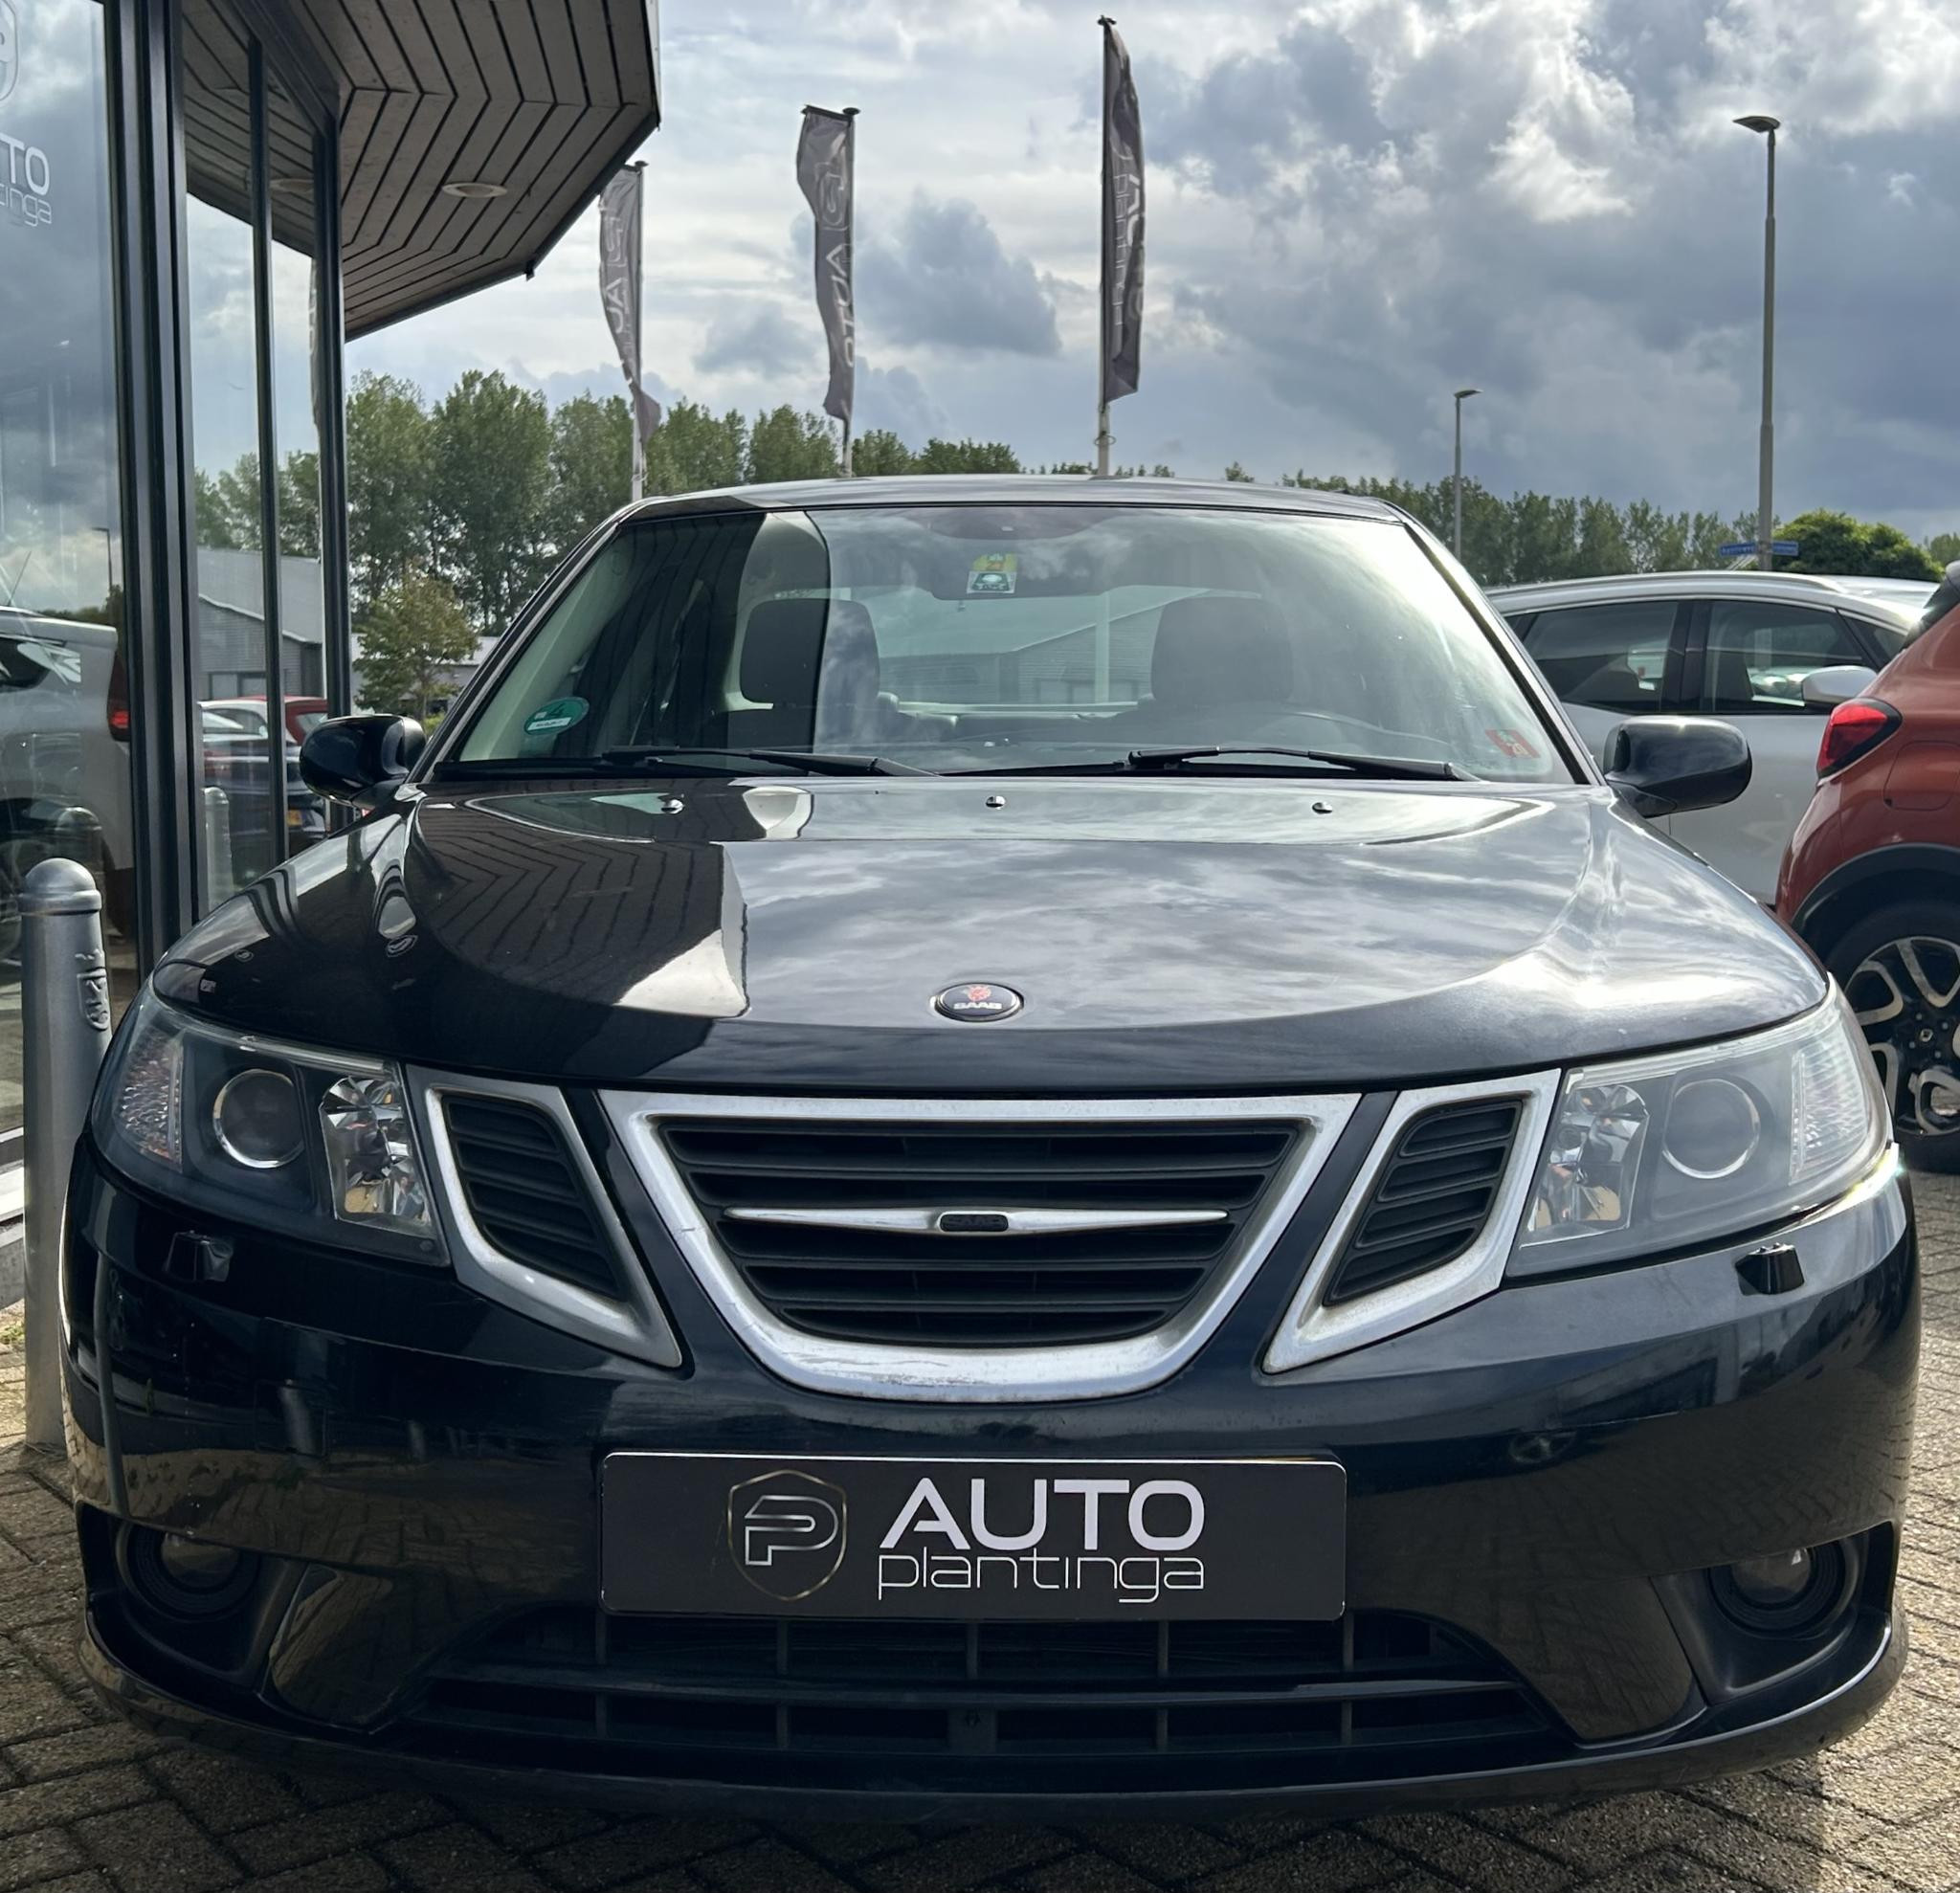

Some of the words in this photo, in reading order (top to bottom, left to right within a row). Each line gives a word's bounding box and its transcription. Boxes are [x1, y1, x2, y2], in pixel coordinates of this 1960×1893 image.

[953, 1001, 1002, 1010] SAAB
[879, 1477, 1205, 1551] AUTO
[879, 1546, 1204, 1604] plantinga
